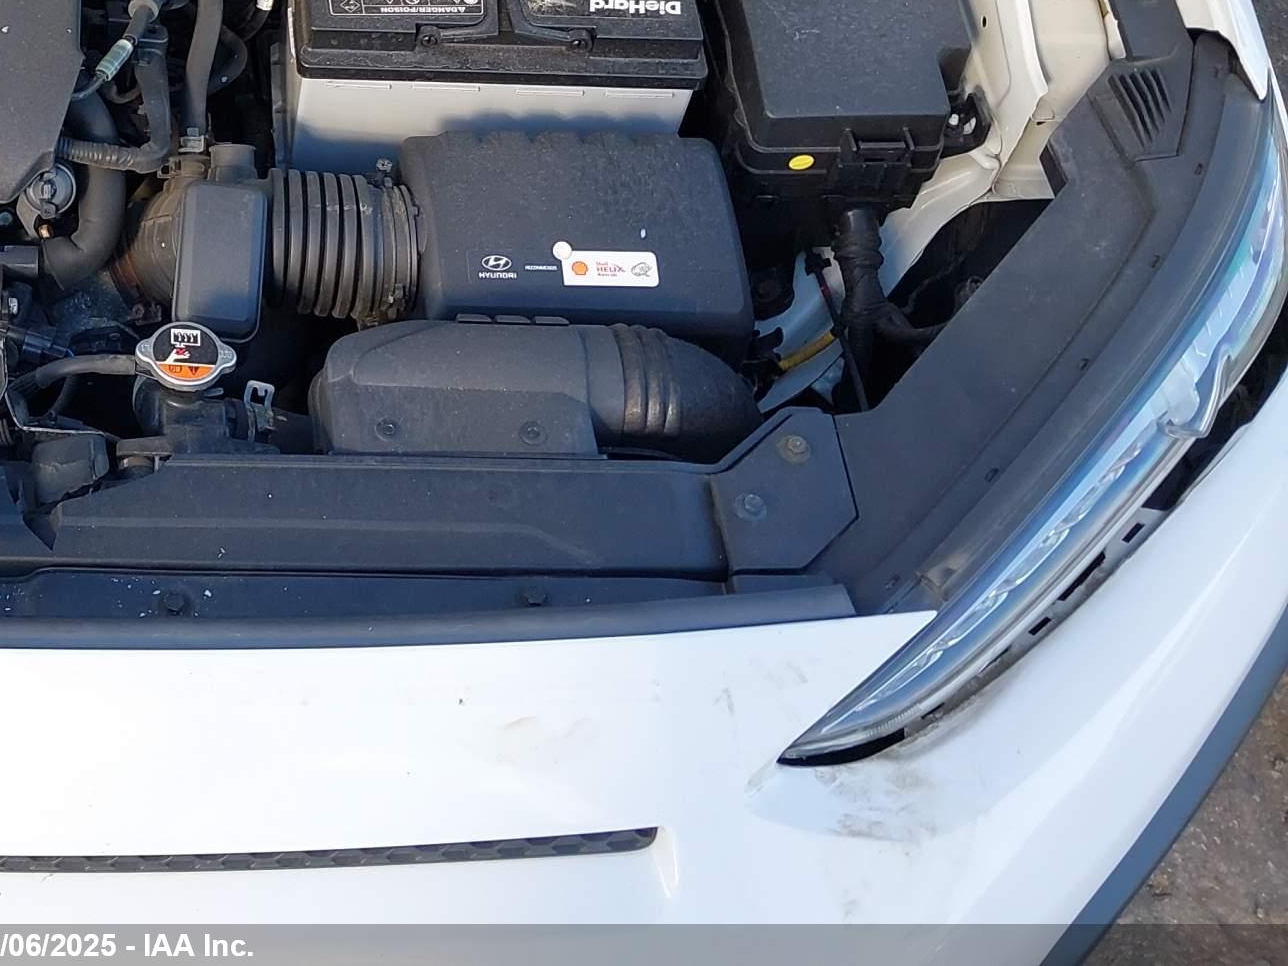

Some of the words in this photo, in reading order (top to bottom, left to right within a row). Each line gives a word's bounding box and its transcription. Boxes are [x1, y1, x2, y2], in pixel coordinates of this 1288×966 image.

[590, 0, 681, 14] DieHard
[596, 265, 626, 273] HELIX
[478, 271, 518, 279] HYUNDAI
